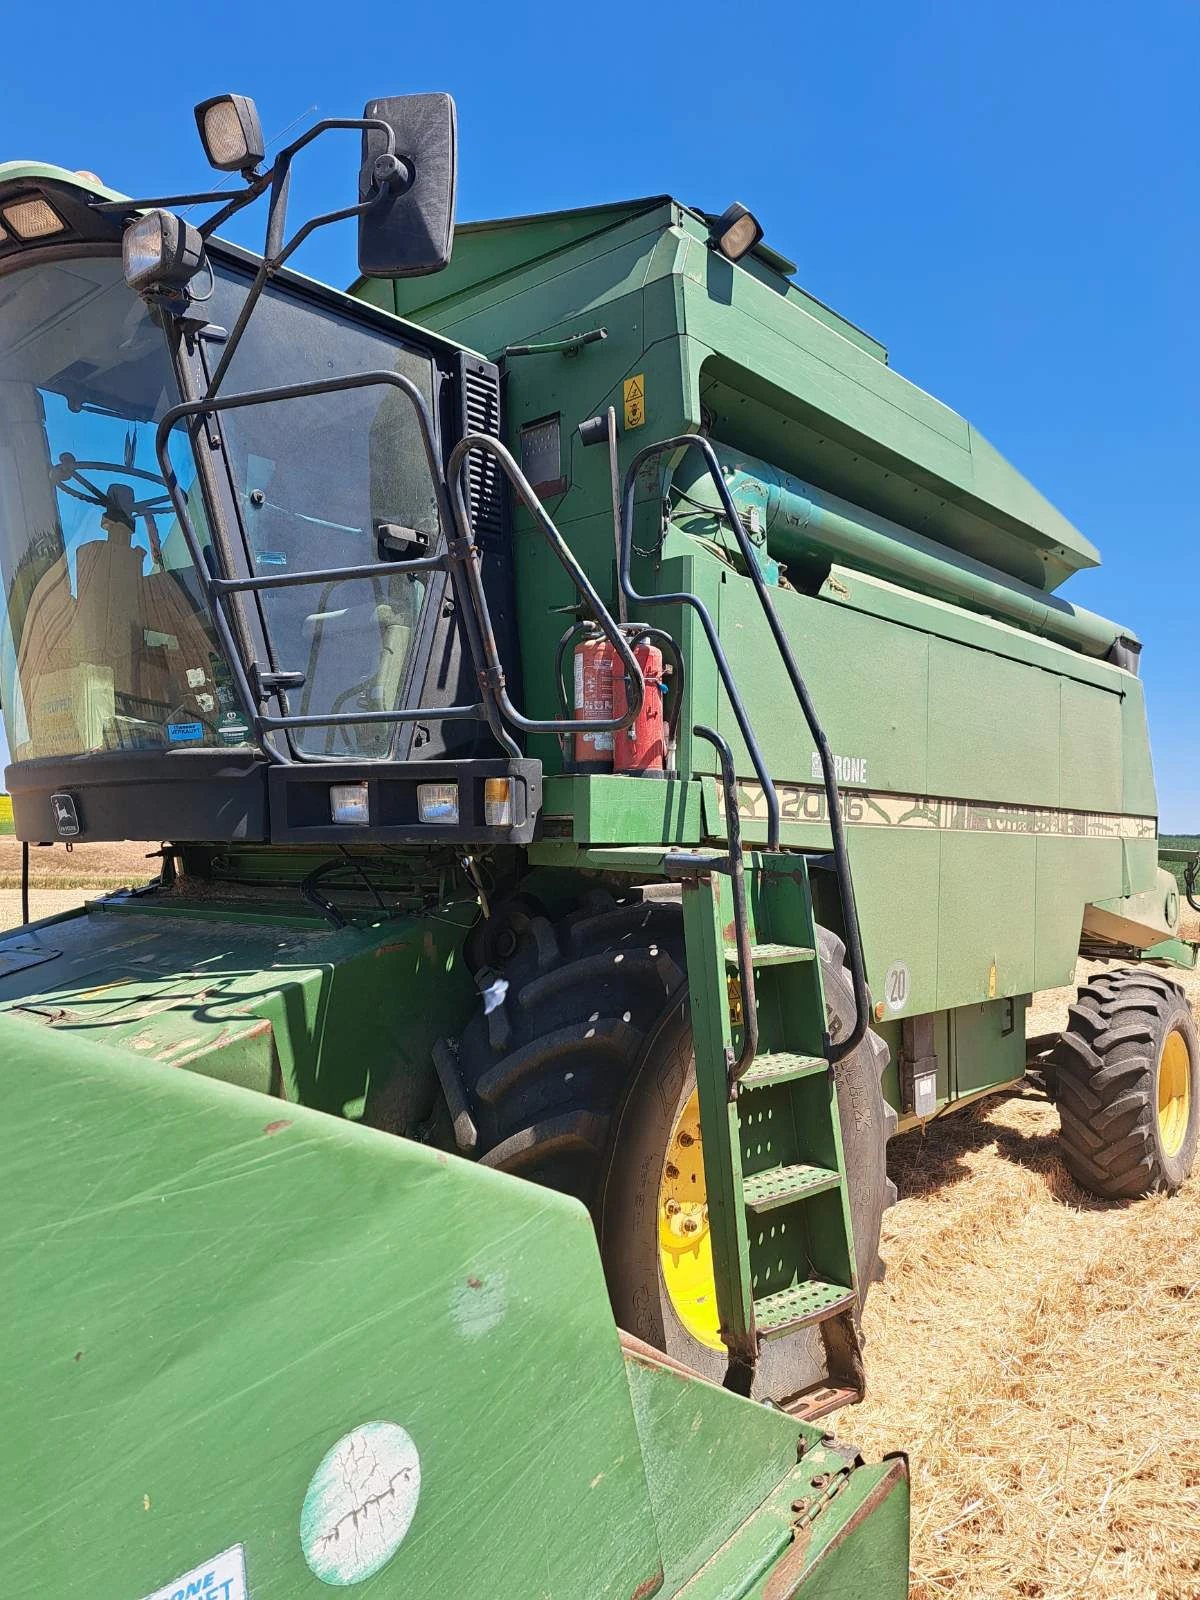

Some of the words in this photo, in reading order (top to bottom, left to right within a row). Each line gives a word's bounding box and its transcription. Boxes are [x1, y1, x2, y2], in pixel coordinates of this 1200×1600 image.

[831, 754, 867, 783] RONE
[782, 787, 863, 820] 206
[890, 969, 905, 1001] 20
[164, 1571, 215, 1600] ONE
